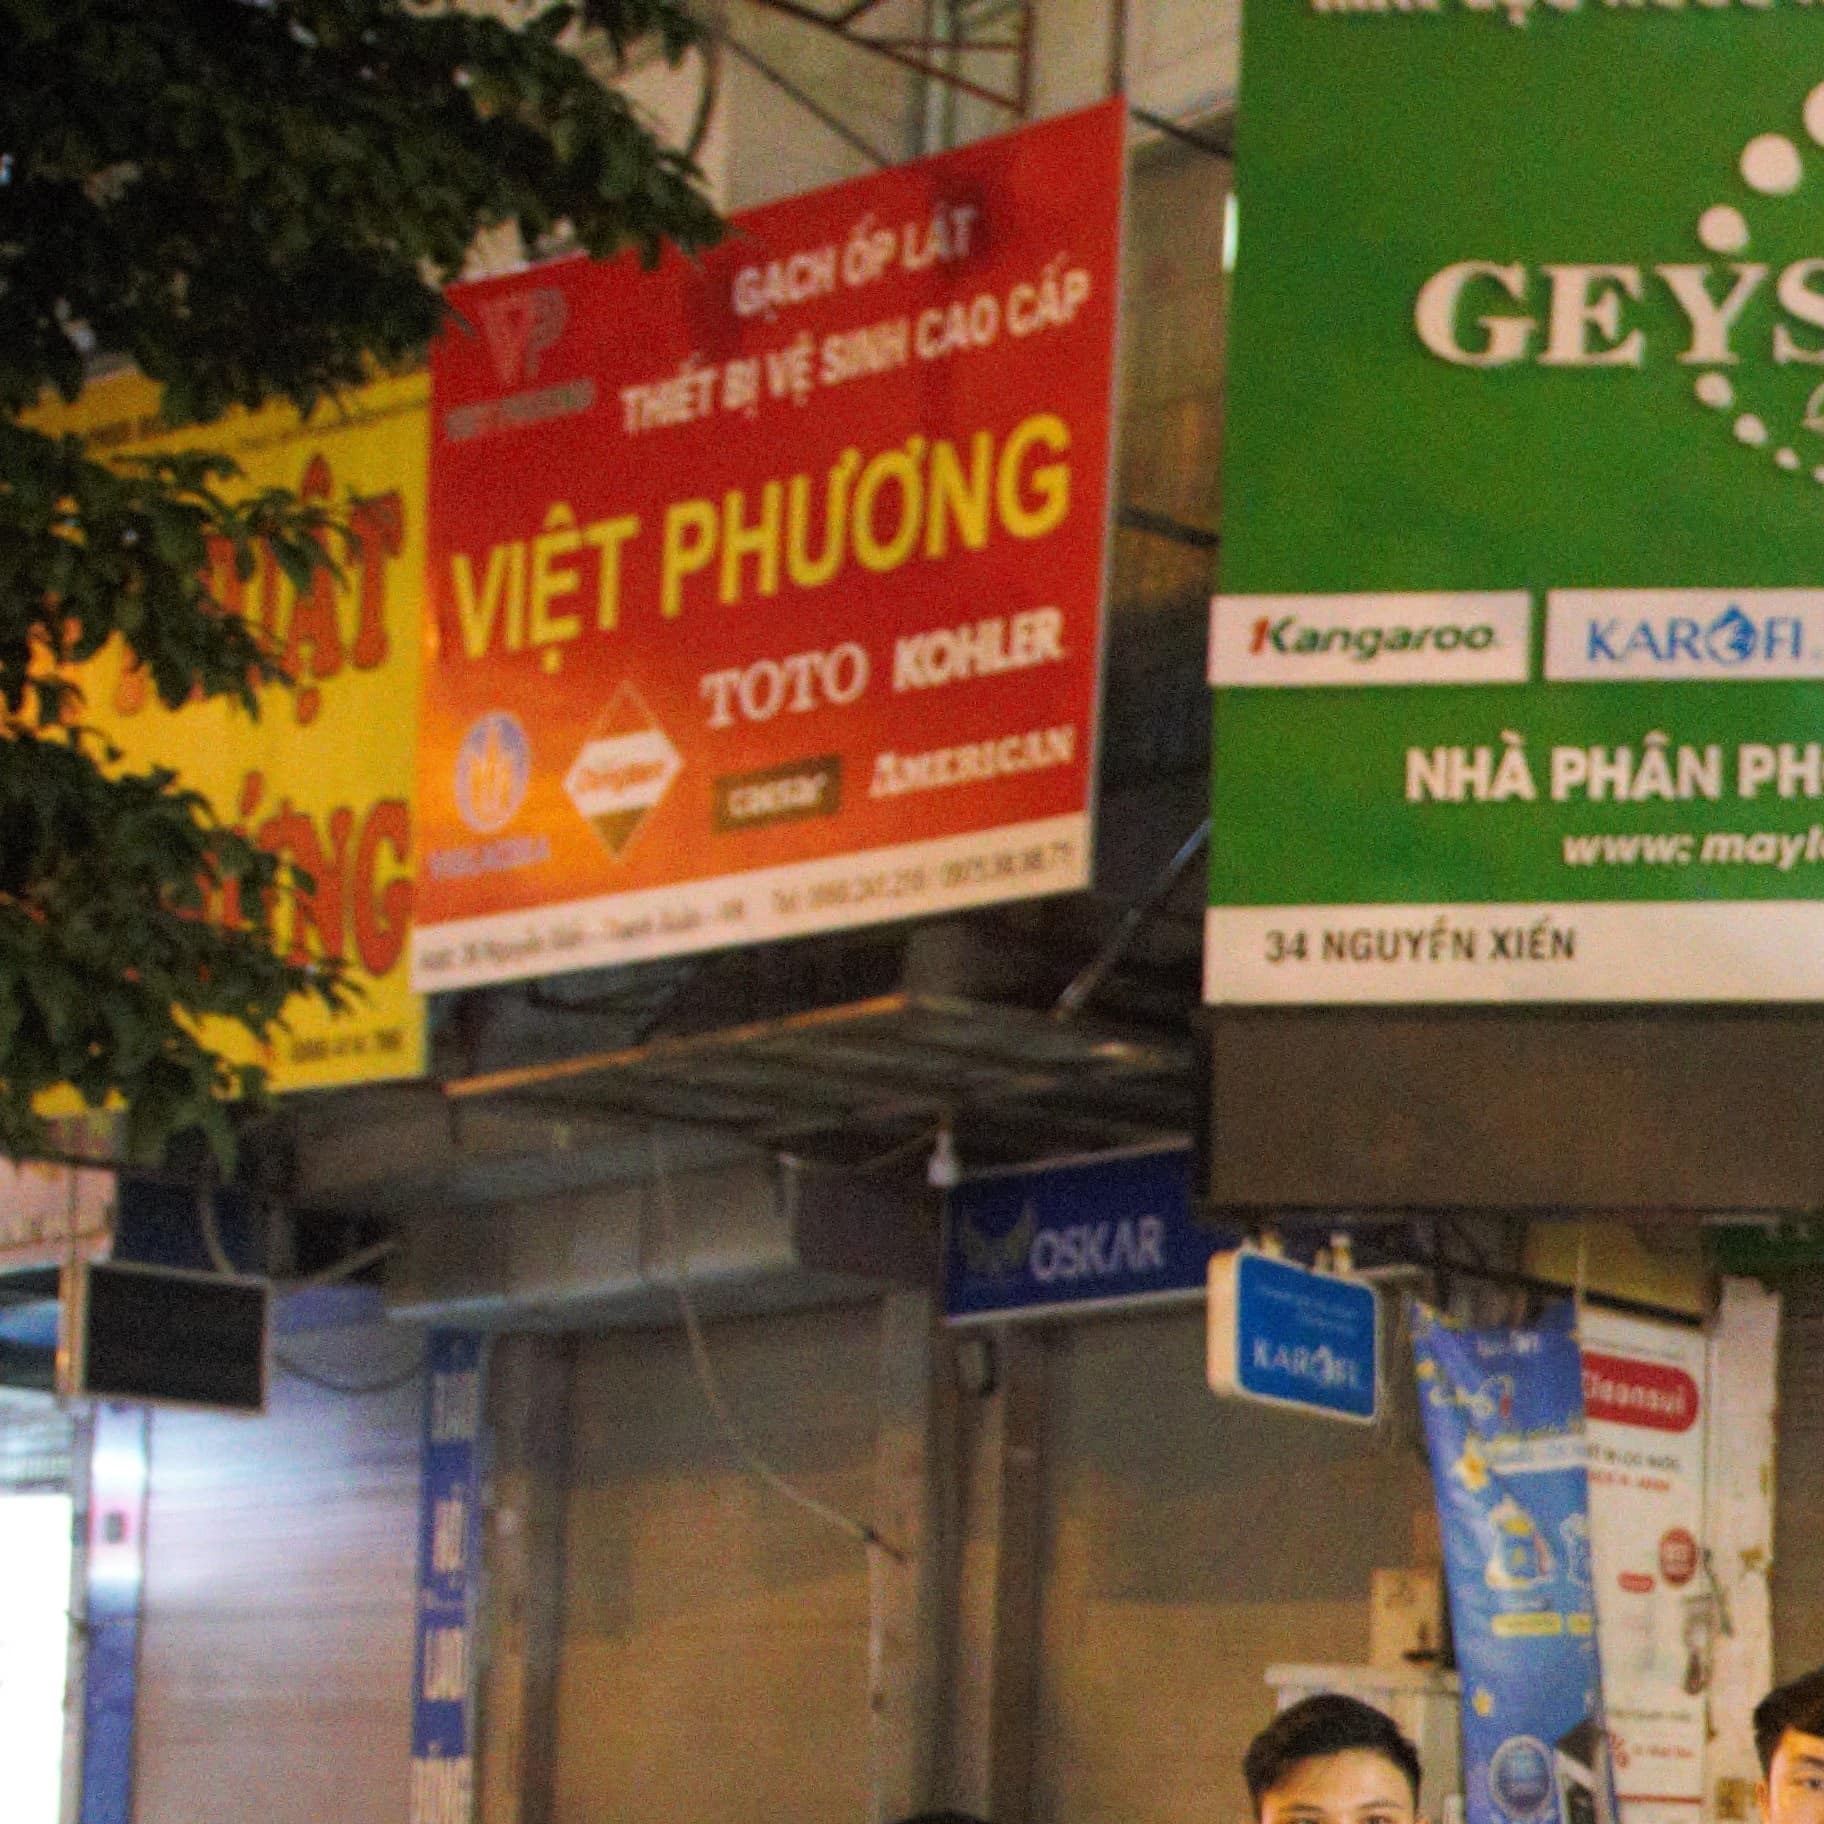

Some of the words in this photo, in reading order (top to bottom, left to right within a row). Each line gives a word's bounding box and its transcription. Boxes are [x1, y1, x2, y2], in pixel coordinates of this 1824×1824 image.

[732, 252, 836, 322] GẠCH
[621, 350, 718, 434] THIẾT
[723, 358, 760, 420] BỊ
[767, 330, 815, 409] VỆ
[820, 316, 911, 388] SINH
[916, 296, 997, 360] CAO
[1008, 250, 1091, 338] CẤP
[452, 500, 638, 674] VIỆT
[663, 414, 1071, 618] PHƯƠNG
[893, 605, 1065, 694] KOHLER
[1249, 613, 1495, 663] Kangaroo
[702, 642, 868, 729] TOTO
[1405, 730, 1533, 802] NHÀ
[1551, 731, 1722, 801] PHÂN
[1264, 929, 1308, 963] 34
[1031, 1215, 1164, 1281] OSKAR
